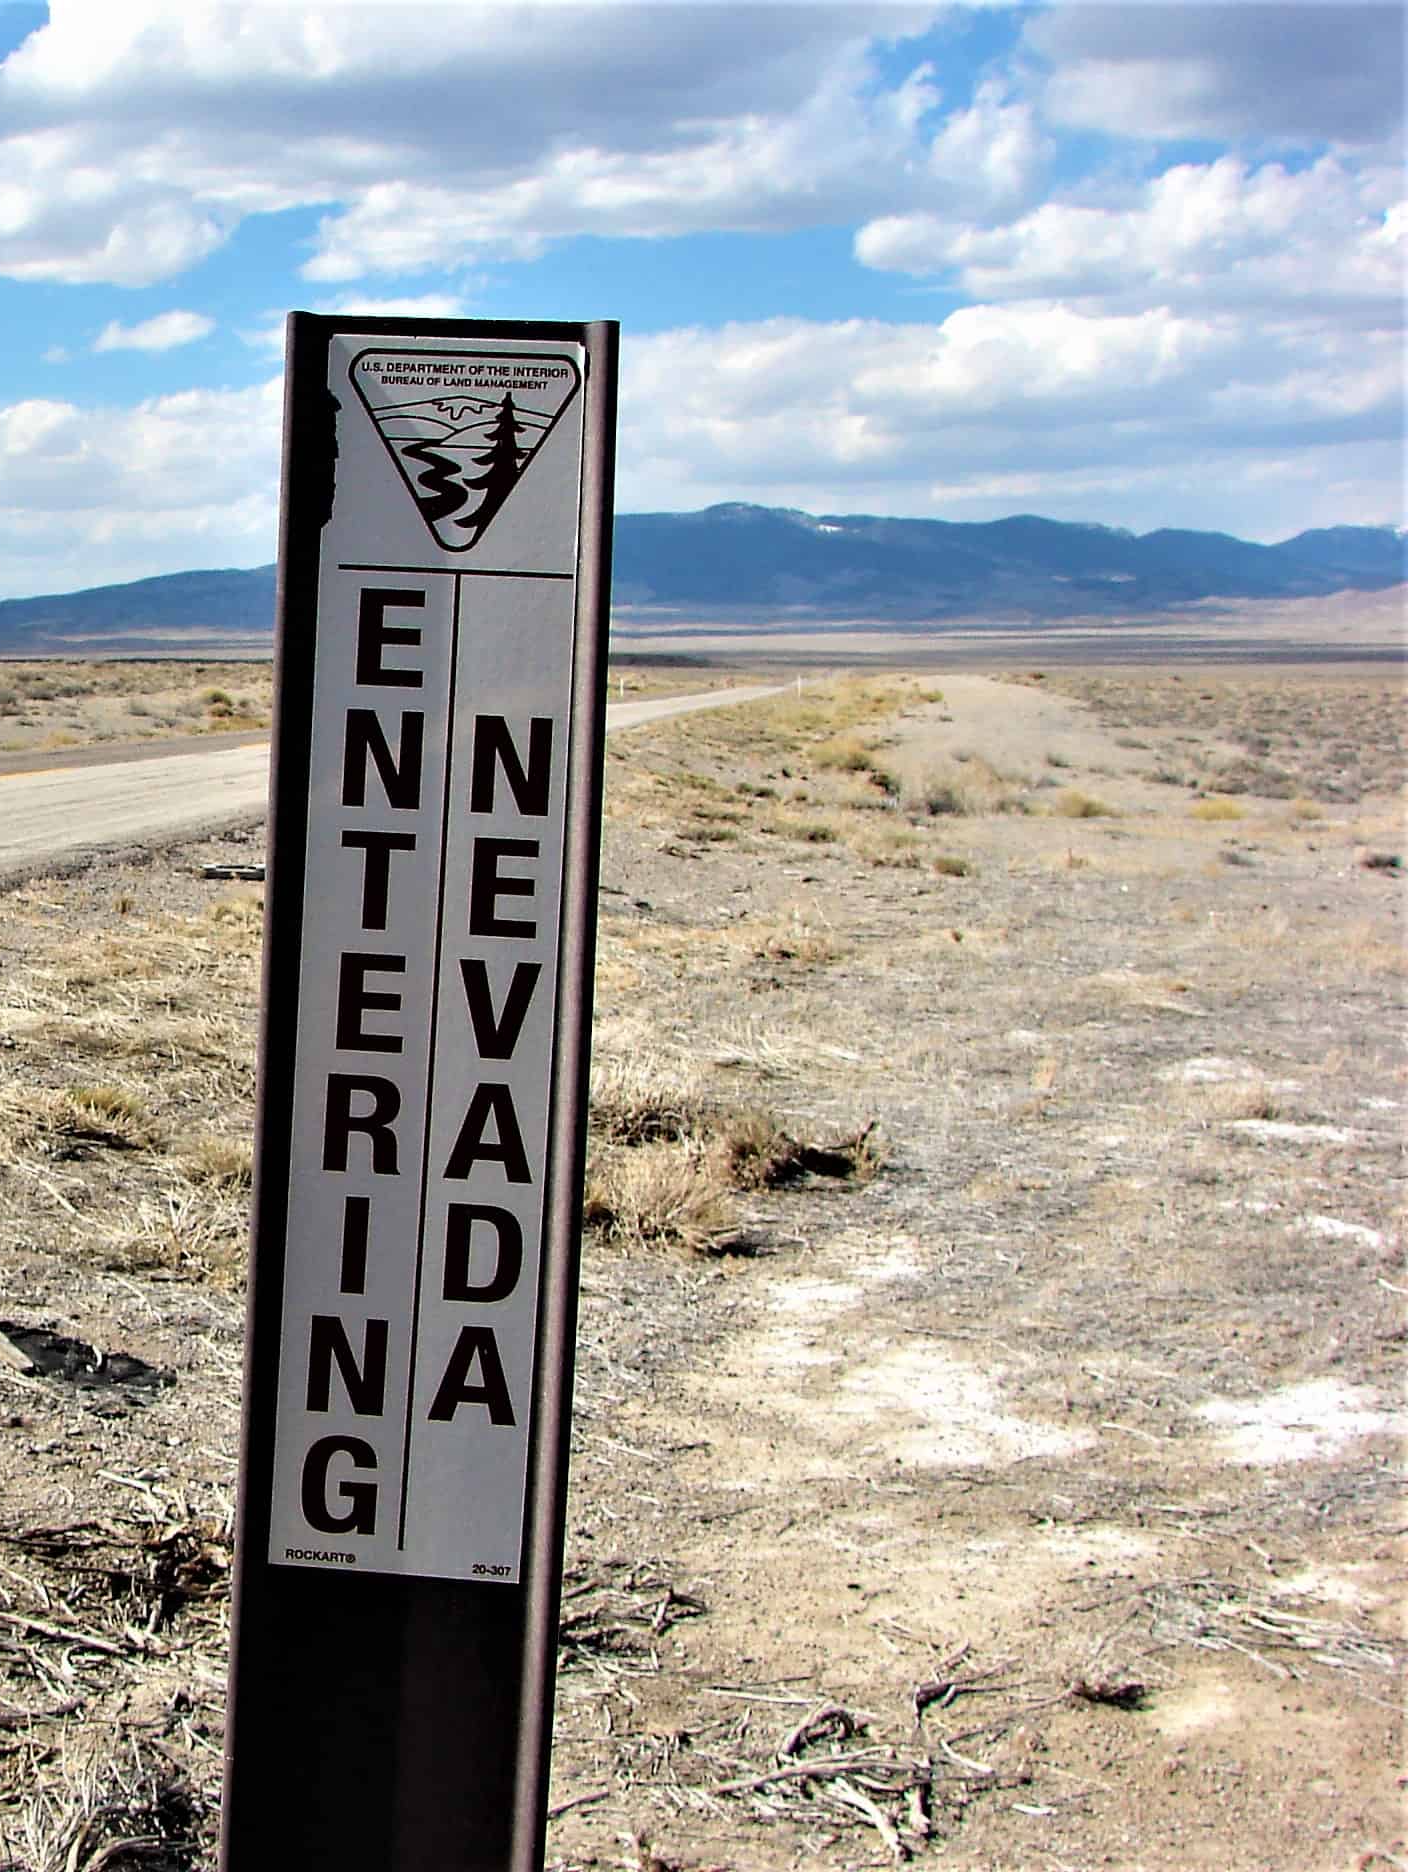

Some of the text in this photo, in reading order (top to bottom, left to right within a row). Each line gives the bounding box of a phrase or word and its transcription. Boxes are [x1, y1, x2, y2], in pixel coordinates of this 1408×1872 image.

[386, 363, 467, 375] DEPARTMENT
[468, 365, 485, 376] OF
[487, 365, 510, 377] THE
[513, 366, 569, 378] INTERIOR
[381, 375, 548, 390] BUREAU OF LAND MANAGEMENT
[301, 587, 426, 1536] ENTERING
[427, 714, 553, 1427] NEVADA
[471, 1563, 511, 1577] 20-307
